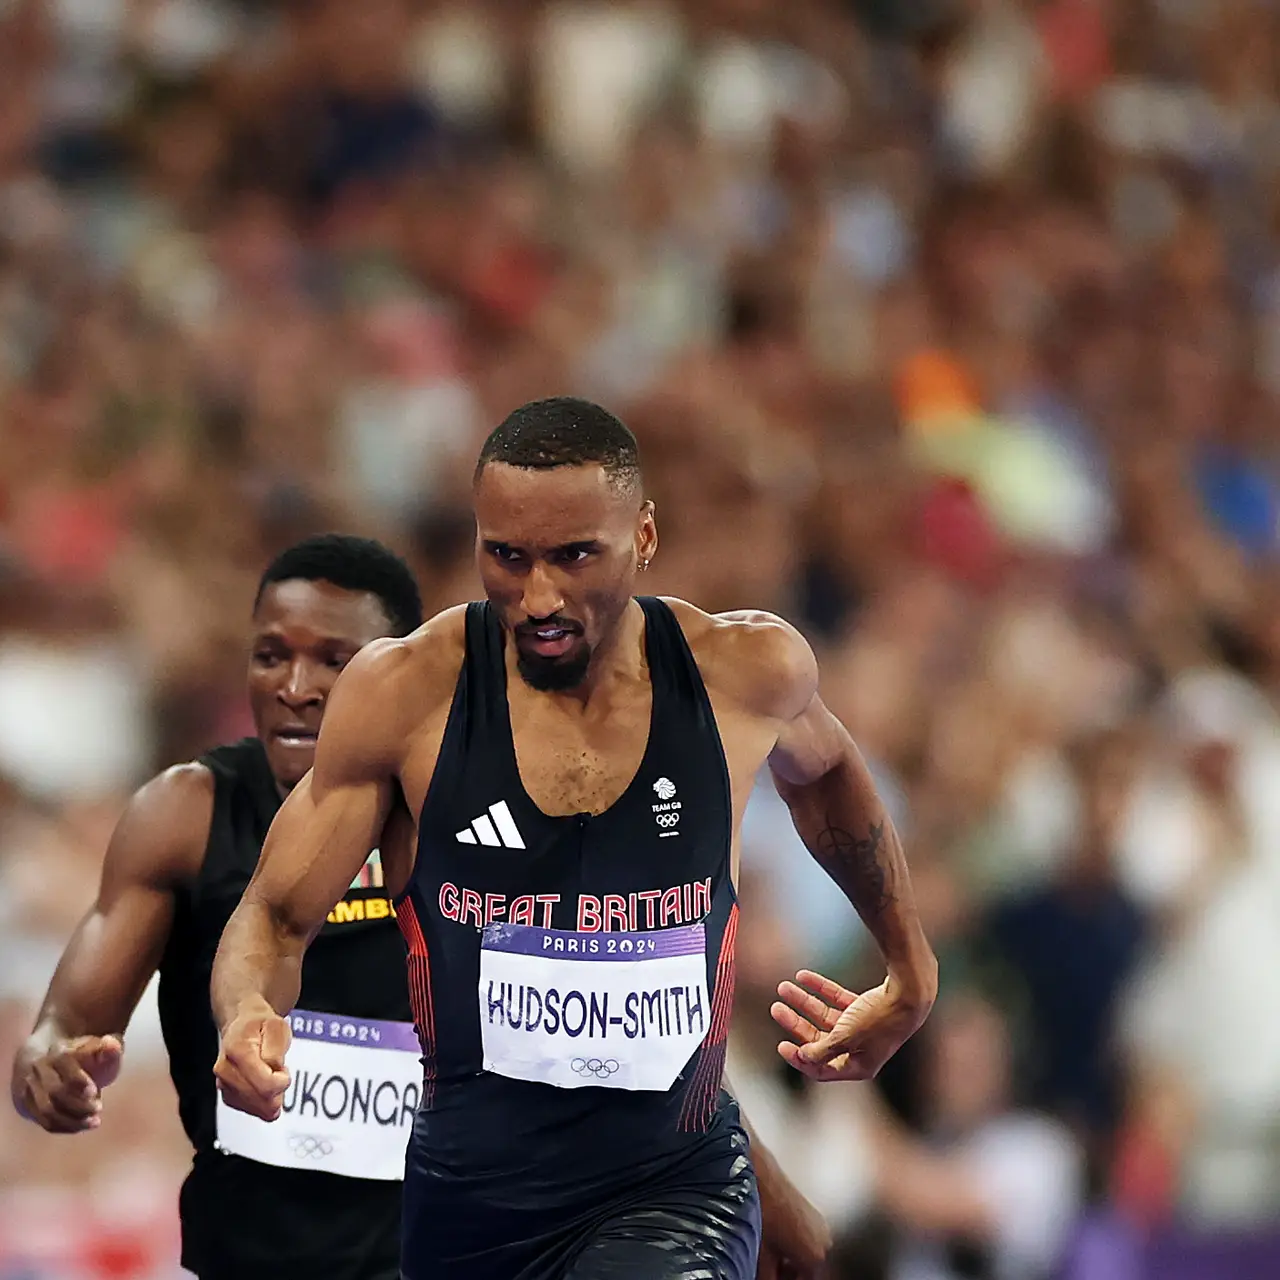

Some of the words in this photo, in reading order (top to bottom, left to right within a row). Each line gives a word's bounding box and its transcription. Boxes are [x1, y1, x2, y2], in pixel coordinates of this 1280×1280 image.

[652, 803, 670, 812] TEAM
[439, 882, 560, 930] GREAT
[577, 877, 712, 933] BRITAIN
[607, 938, 656, 953] 2024
[487, 980, 705, 1039] HUDSON-SMITH
[330, 1021, 382, 1041] 2024
[282, 1069, 420, 1127] UKONGA
